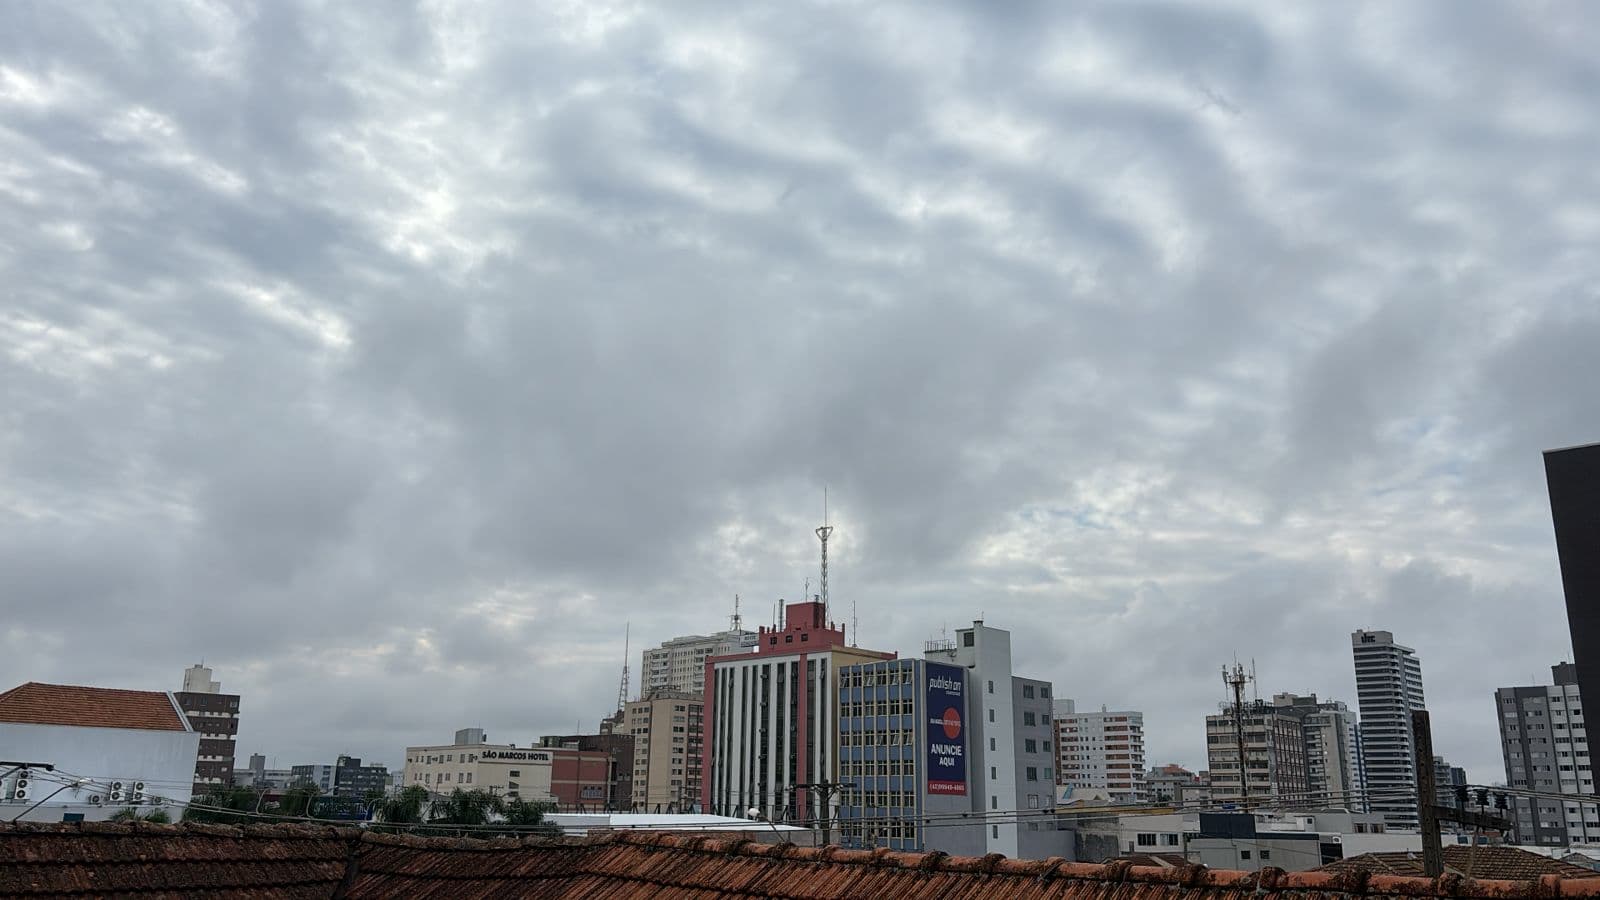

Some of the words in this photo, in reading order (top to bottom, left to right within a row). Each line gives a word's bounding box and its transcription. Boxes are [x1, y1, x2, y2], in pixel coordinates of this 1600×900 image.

[953, 681, 961, 691] on
[482, 750, 497, 759] SÃO
[498, 752, 526, 760] MARCOS
[528, 752, 549, 761] HOTEL
[931, 744, 962, 757] ANUNCIE
[939, 757, 955, 767] AQUI
